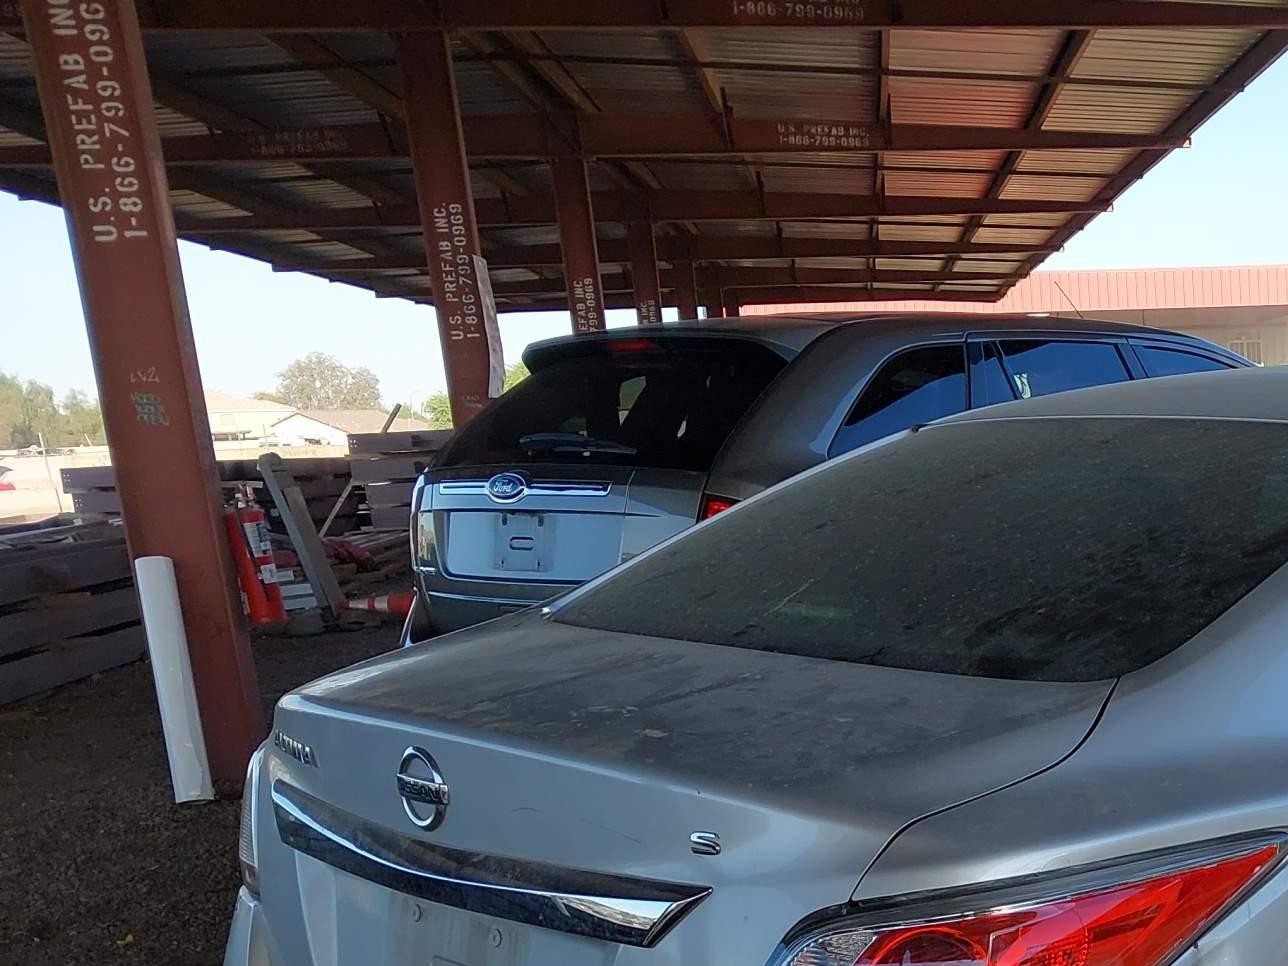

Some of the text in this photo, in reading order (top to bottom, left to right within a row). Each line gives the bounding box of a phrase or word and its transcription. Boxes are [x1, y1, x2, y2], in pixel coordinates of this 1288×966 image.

[59, 52, 105, 169] PREFAB
[88, 187, 118, 242] U.S.
[433, 202, 464, 340] U.S. PREFAB INC.
[449, 203, 480, 338] 1-866-799-0969
[493, 480, 513, 492] Ford
[690, 831, 721, 856] S
